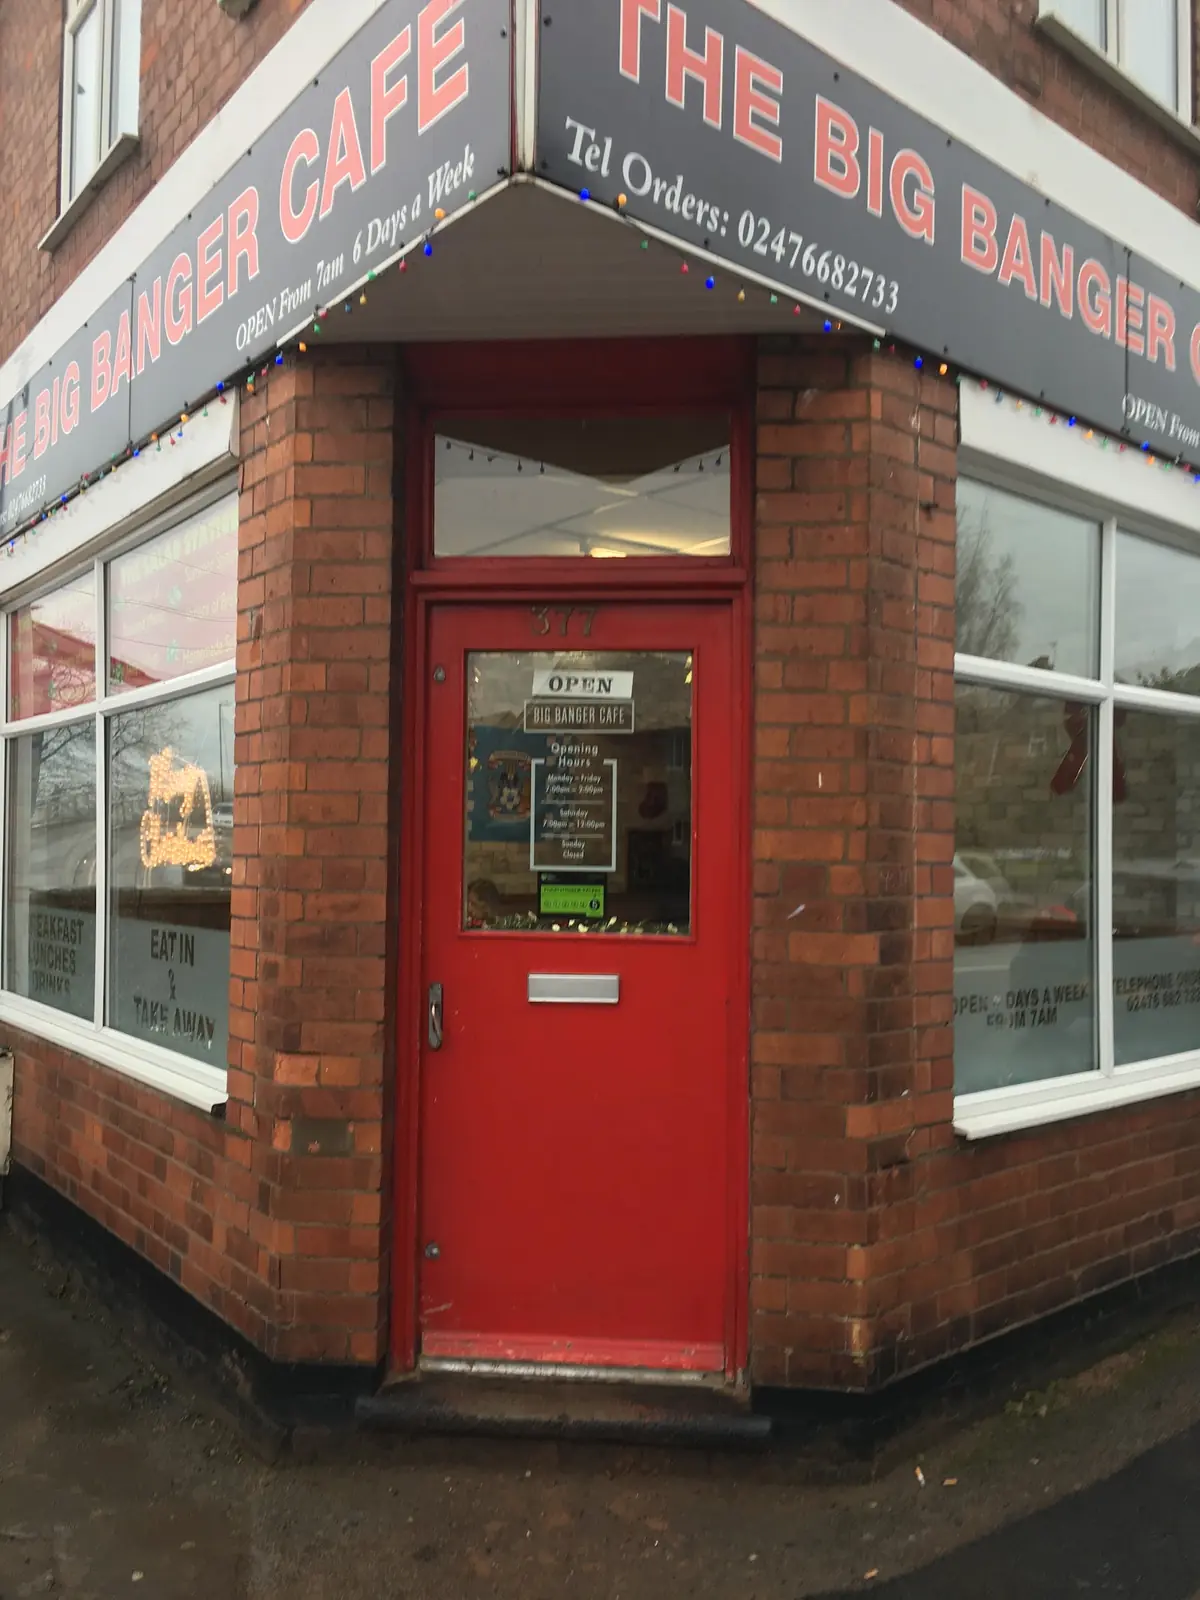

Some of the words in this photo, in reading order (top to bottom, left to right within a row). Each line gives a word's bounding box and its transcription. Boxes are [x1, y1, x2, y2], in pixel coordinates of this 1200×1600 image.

[619, 0, 783, 164] THE
[814, 93, 935, 247] BIG
[960, 181, 1176, 372] BANGER
[34, 361, 80, 460] BIG
[91, 186, 260, 413] BANGER
[279, 0, 469, 244] CAFE
[565, 116, 613, 177] Tel
[622, 152, 730, 237] Orders:
[737, 210, 900, 315] 02476682733
[236, 296, 277, 351] OPEN
[278, 279, 311, 322] From
[316, 252, 344, 293] 7am
[353, 230, 362, 265] 6
[365, 203, 408, 258] Days
[411, 193, 421, 222] a
[427, 143, 475, 209] Week
[1121, 393, 1168, 434] OPEN
[530, 604, 599, 637] 377
[549, 675, 613, 694] OPEN
[533, 706, 551, 724] BIG
[555, 705, 596, 724] BANGER
[599, 706, 625, 725] CAFE
[551, 742, 600, 756] Opening
[558, 756, 591, 767] Hours
[150, 929, 177, 962] EAT
[180, 933, 195, 967] IN
[1006, 988, 1039, 1009] DAYS
[1043, 986, 1051, 1005] A
[1053, 981, 1090, 1005] WEEK
[133, 995, 168, 1033] TAKE
[173, 1007, 216, 1042] AWAY
[1030, 1006, 1058, 1028] 7AM
